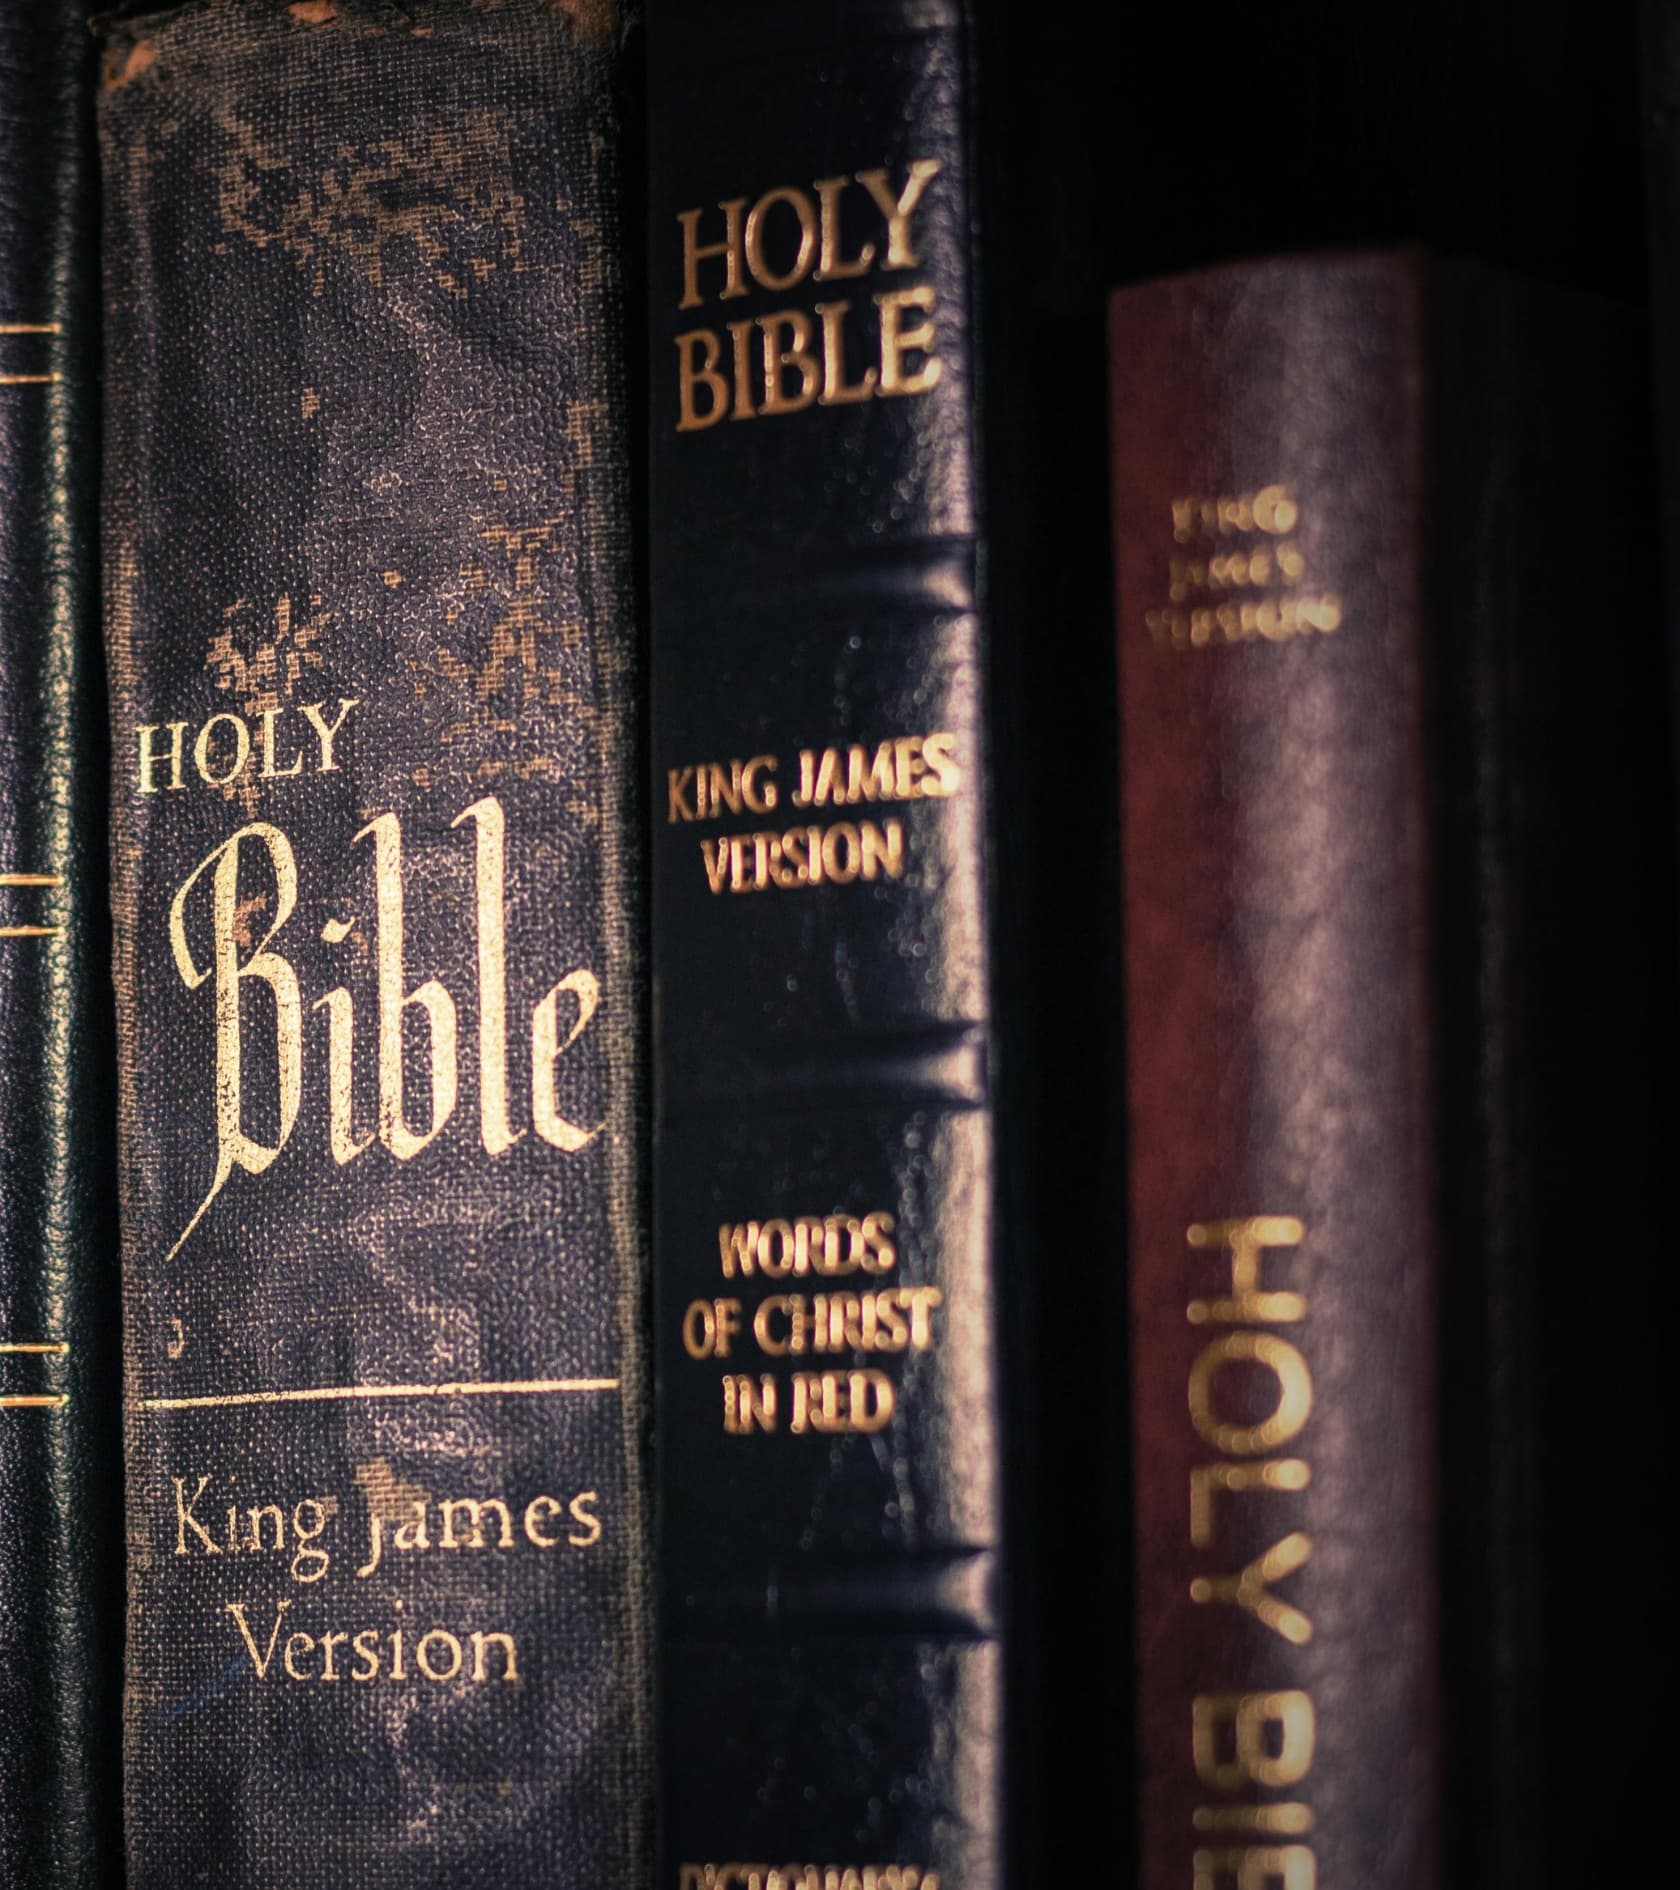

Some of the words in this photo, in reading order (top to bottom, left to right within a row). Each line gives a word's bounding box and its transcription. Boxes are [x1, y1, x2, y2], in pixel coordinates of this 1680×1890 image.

[676, 158, 942, 310] HOLY
[674, 286, 943, 432] BIBLE
[136, 699, 359, 793] HOLY
[667, 754, 780, 823] KING
[792, 732, 963, 808] JAMES
[701, 817, 903, 894] VERSION
[166, 797, 605, 1262] Bible
[719, 1211, 895, 1278] WORDS
[682, 1298, 741, 1359] OF
[754, 1286, 943, 1356] CHRIST
[722, 1374, 776, 1434] IN
[790, 1368, 895, 1434] RED
[1186, 1215, 1313, 1645] HOLY
[173, 1475, 329, 1583] King
[357, 1478, 603, 1578] James
[226, 1600, 520, 1682] Version
